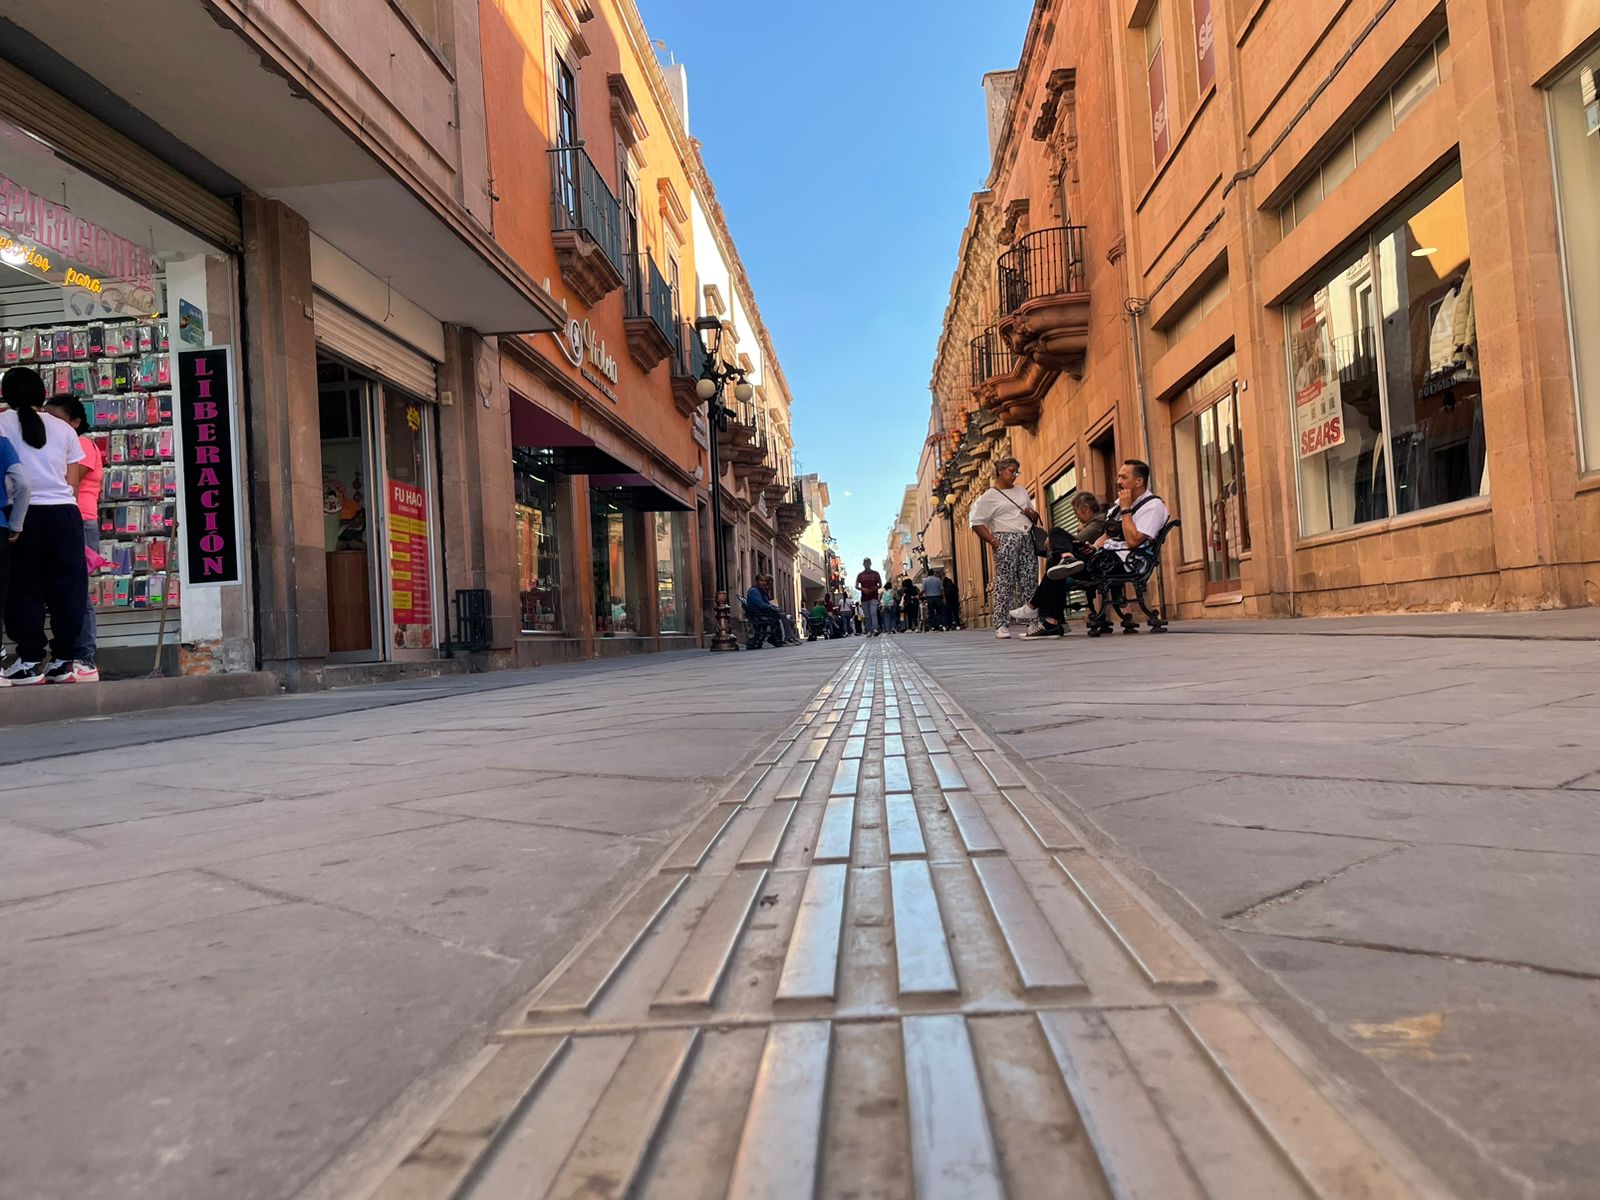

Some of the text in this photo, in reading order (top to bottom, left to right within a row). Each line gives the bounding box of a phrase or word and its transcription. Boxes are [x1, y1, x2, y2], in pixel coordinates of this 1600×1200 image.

[62, 267, 102, 293] para
[1301, 416, 1341, 455] SEARS
[192, 357, 225, 576] LIBERACIÓN
[394, 486, 423, 507] FU HAO
